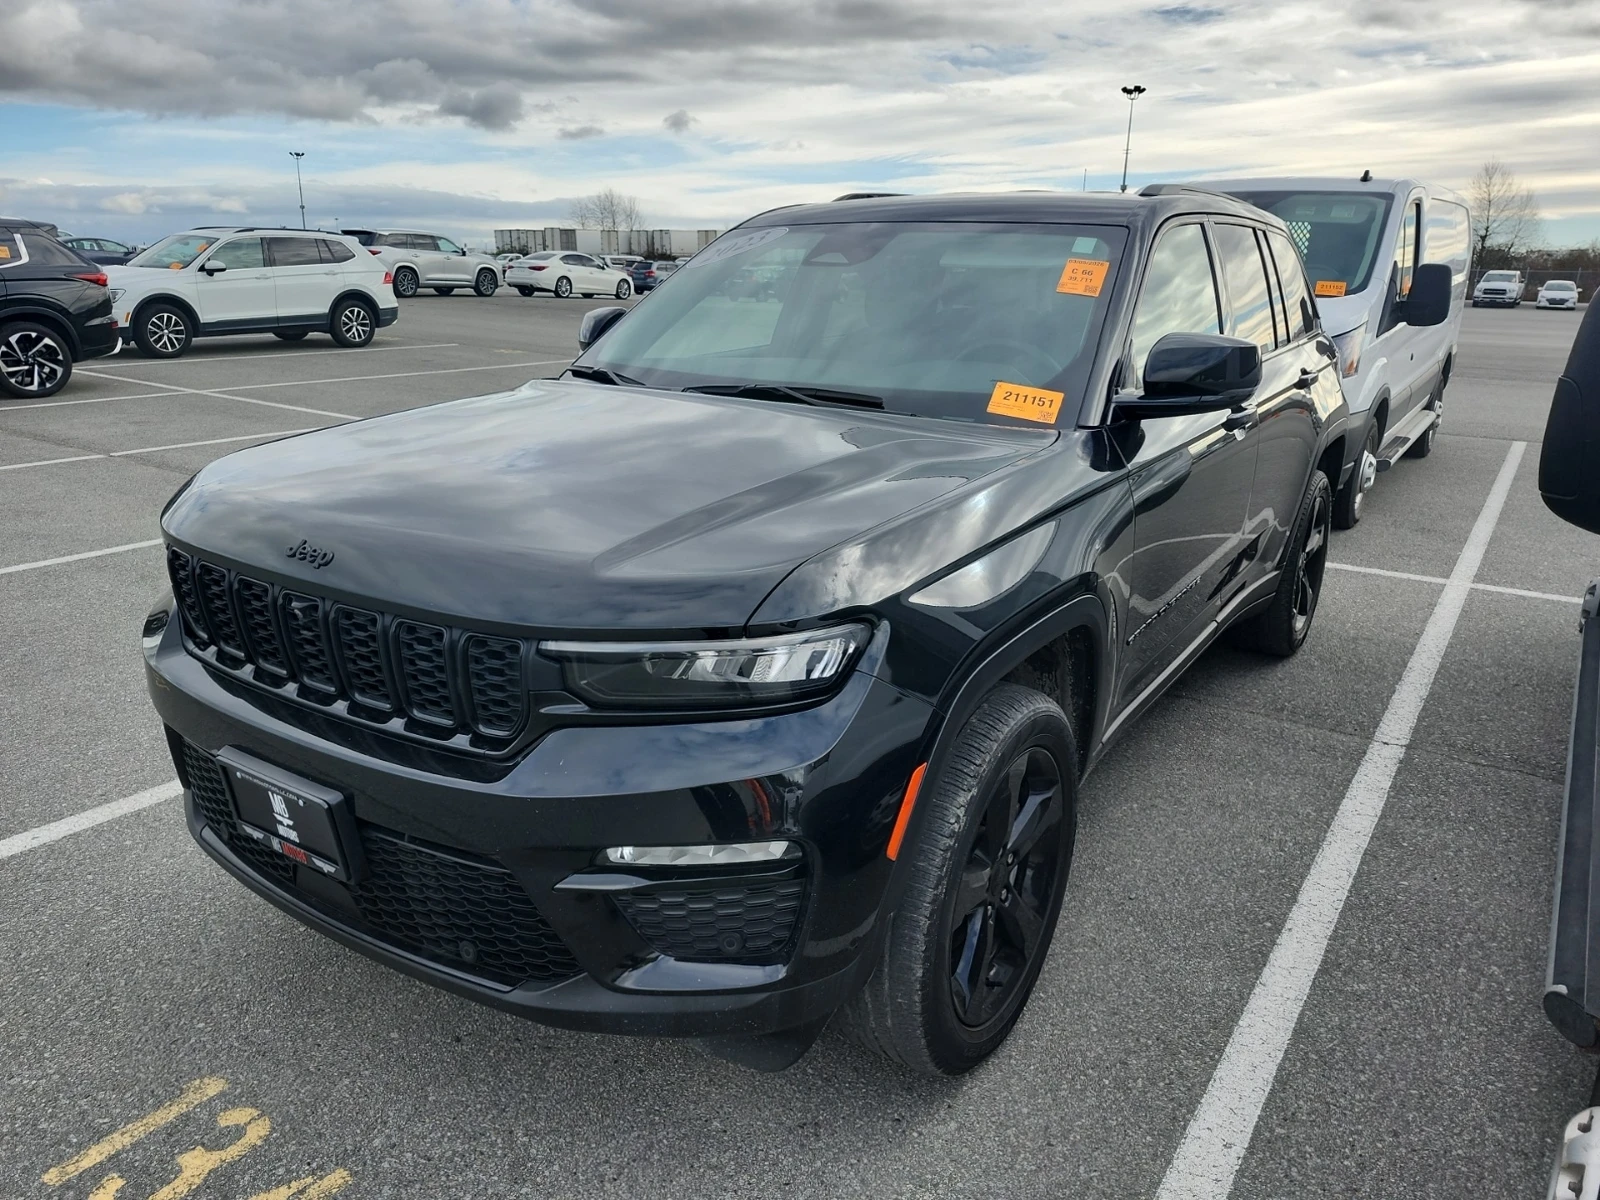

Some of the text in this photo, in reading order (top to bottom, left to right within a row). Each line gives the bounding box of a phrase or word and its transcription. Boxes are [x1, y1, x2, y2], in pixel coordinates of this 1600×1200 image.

[1081, 269, 1094, 277] 66
[1002, 390, 1055, 409] 211151
[284, 539, 335, 570] Jeep
